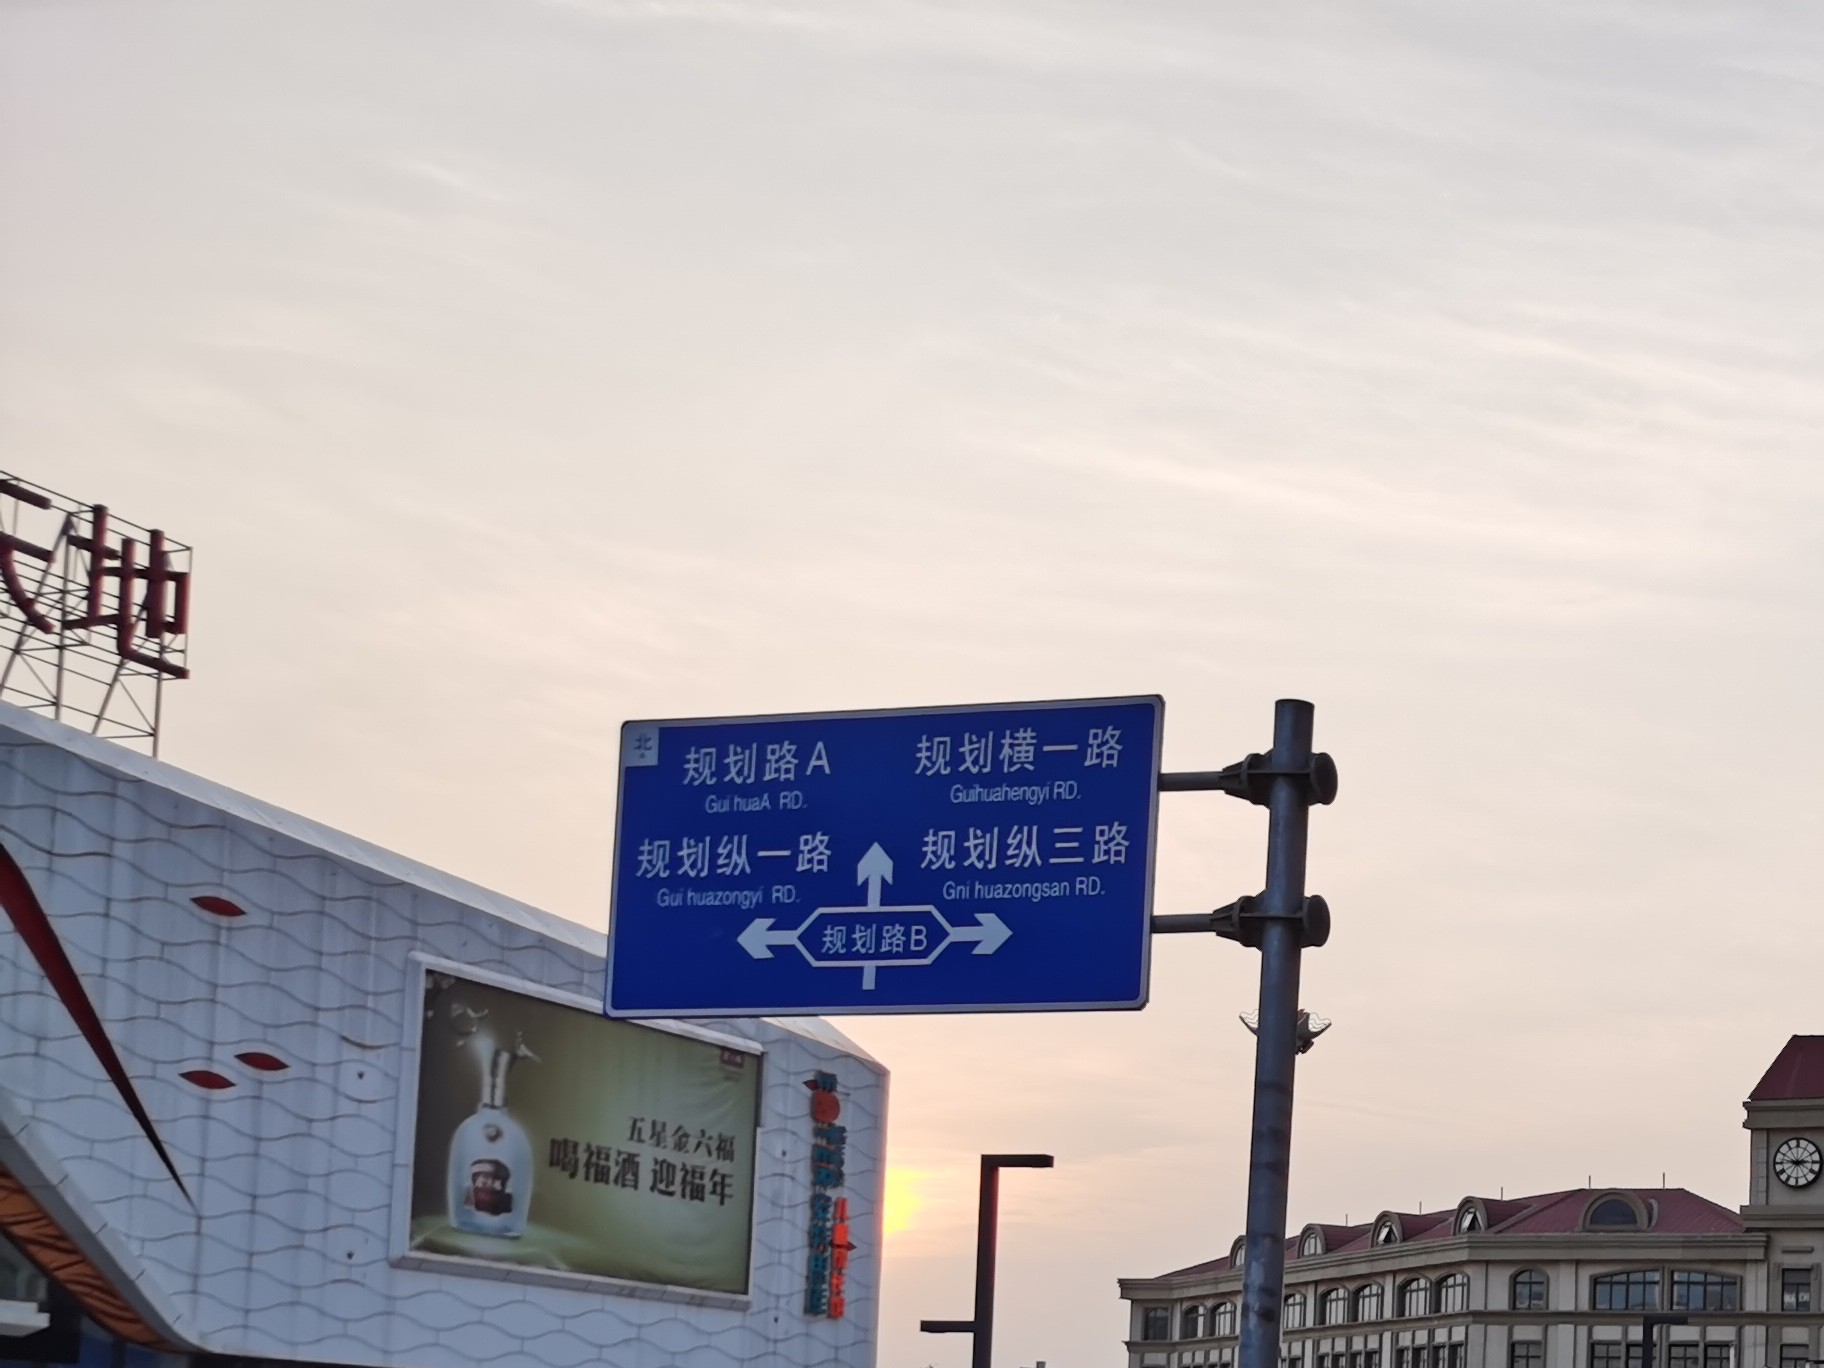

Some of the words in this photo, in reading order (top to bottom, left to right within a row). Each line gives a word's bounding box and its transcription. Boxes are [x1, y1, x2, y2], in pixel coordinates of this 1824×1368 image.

[634, 732, 653, 752] 北
[914, 725, 1123, 777] 规划横一路
[682, 740, 831, 787] 规划路A
[705, 794, 730, 813] Gui
[779, 791, 808, 811] RD.
[950, 782, 1050, 806] Guihuahengyi
[1053, 781, 1082, 800] RD.
[636, 831, 832, 879] 规划纵一路
[920, 821, 1130, 870] 规划纵三路
[687, 885, 763, 910] huazongyi
[771, 884, 801, 904] RD.
[974, 880, 1070, 903] huazongsan
[1075, 876, 1106, 897] RD.
[821, 923, 928, 955] 规划路B
[626, 1116, 736, 1163] 五星金六福
[549, 1138, 641, 1191] 喝福酒
[650, 1156, 734, 1207] 迎福年
